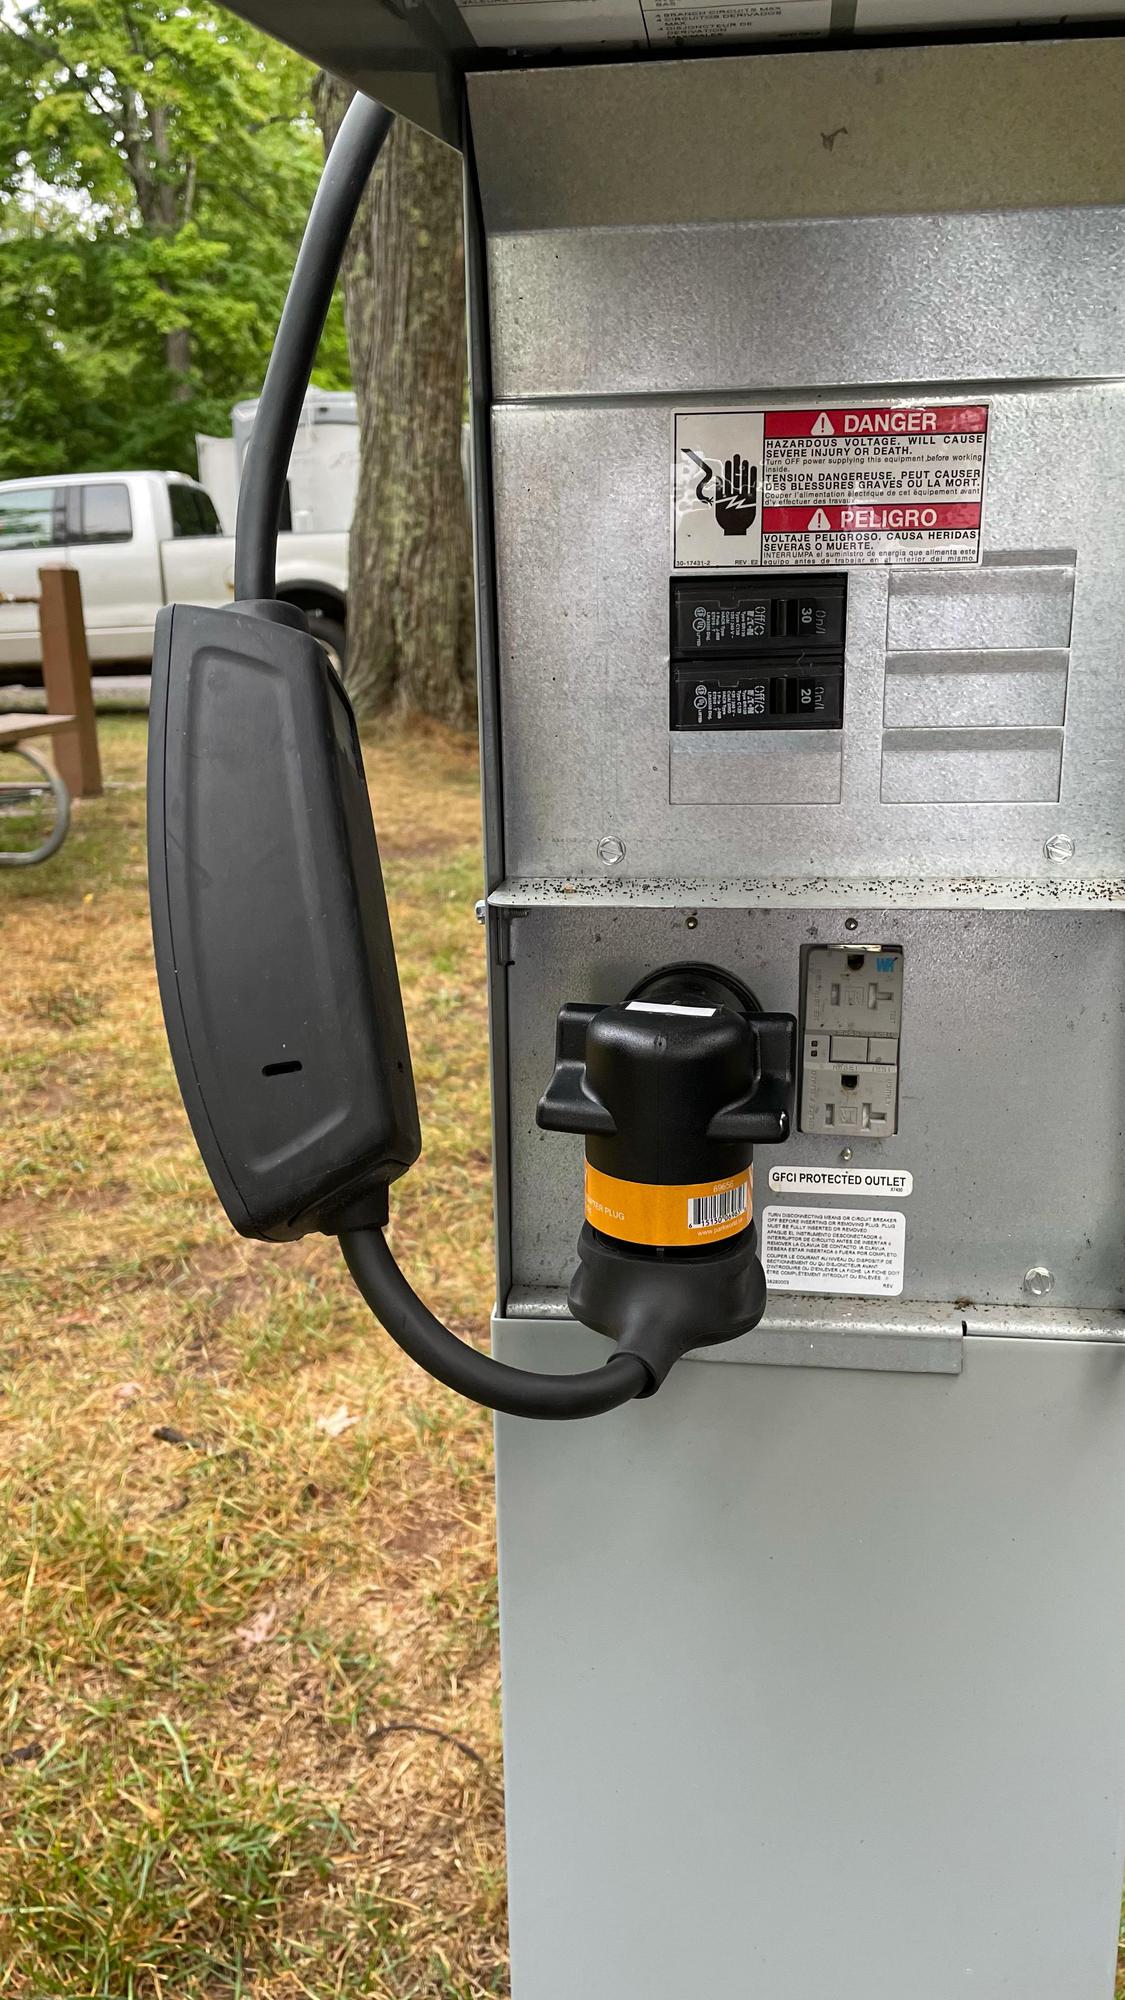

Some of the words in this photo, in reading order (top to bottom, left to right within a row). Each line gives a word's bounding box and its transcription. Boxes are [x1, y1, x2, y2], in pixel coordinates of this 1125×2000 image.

[665, 23, 736, 31] DISJONCTEUR
[844, 413, 937, 433] DANGER
[766, 439, 838, 449] HAZARDOUS
[844, 437, 901, 447] VOLTAGE.
[908, 436, 936, 445] WILL
[943, 434, 983, 445] CAUSE
[766, 448, 808, 458] SEVERE
[811, 447, 851, 457] INJURY
[854, 447, 870, 456] OR
[873, 446, 913, 456] DEATH.
[784, 457, 800, 465] OFF
[803, 458, 826, 466] power
[828, 456, 865, 466] supplying
[867, 455, 882, 463] this
[884, 455, 924, 464] equipment
[952, 453, 982, 462] working
[765, 465, 790, 473] inside.
[766, 473, 813, 483] TENSION
[818, 471, 896, 482] DANGEREUSE.
[901, 470, 930, 480] PEUT
[934, 469, 980, 479] CAUSER
[765, 482, 786, 492] DES
[791, 481, 854, 491] BLESSURES
[858, 480, 903, 490] GRAVES
[907, 479, 923, 488] OU
[927, 479, 941, 488] LA
[945, 478, 980, 488] MORT.
[764, 491, 792, 499] Couper
[898, 488, 911, 496] cet
[960, 487, 980, 495] avant
[813, 497, 827, 505] des
[841, 509, 937, 529] PELIGRO
[764, 534, 810, 543] VOLTAJE
[815, 532, 881, 542] PELIGROSO.
[886, 531, 923, 541] CAUSA
[928, 530, 976, 540] HERIDAS
[764, 543, 811, 552] SEVERAS
[814, 542, 823, 551] O
[826, 541, 874, 551] MUERTE.
[763, 551, 814, 559] INTERRUMPA
[816, 550, 823, 558] el
[826, 549, 864, 557] suministro
[908, 549, 923, 558] que
[925, 548, 957, 556] alimenta
[763, 558, 790, 567] equipo
[820, 557, 829, 565] de
[835, 556, 865, 565] trabajar
[930, 554, 943, 562] del
[801, 607, 812, 624] 30
[801, 688, 812, 704] 20
[876, 957, 895, 973] WR
[772, 1172, 797, 1183] GFCI
[799, 1173, 862, 1185] PROTECTED
[864, 1175, 906, 1188] OUTLET
[604, 1207, 625, 1221] PLUG
